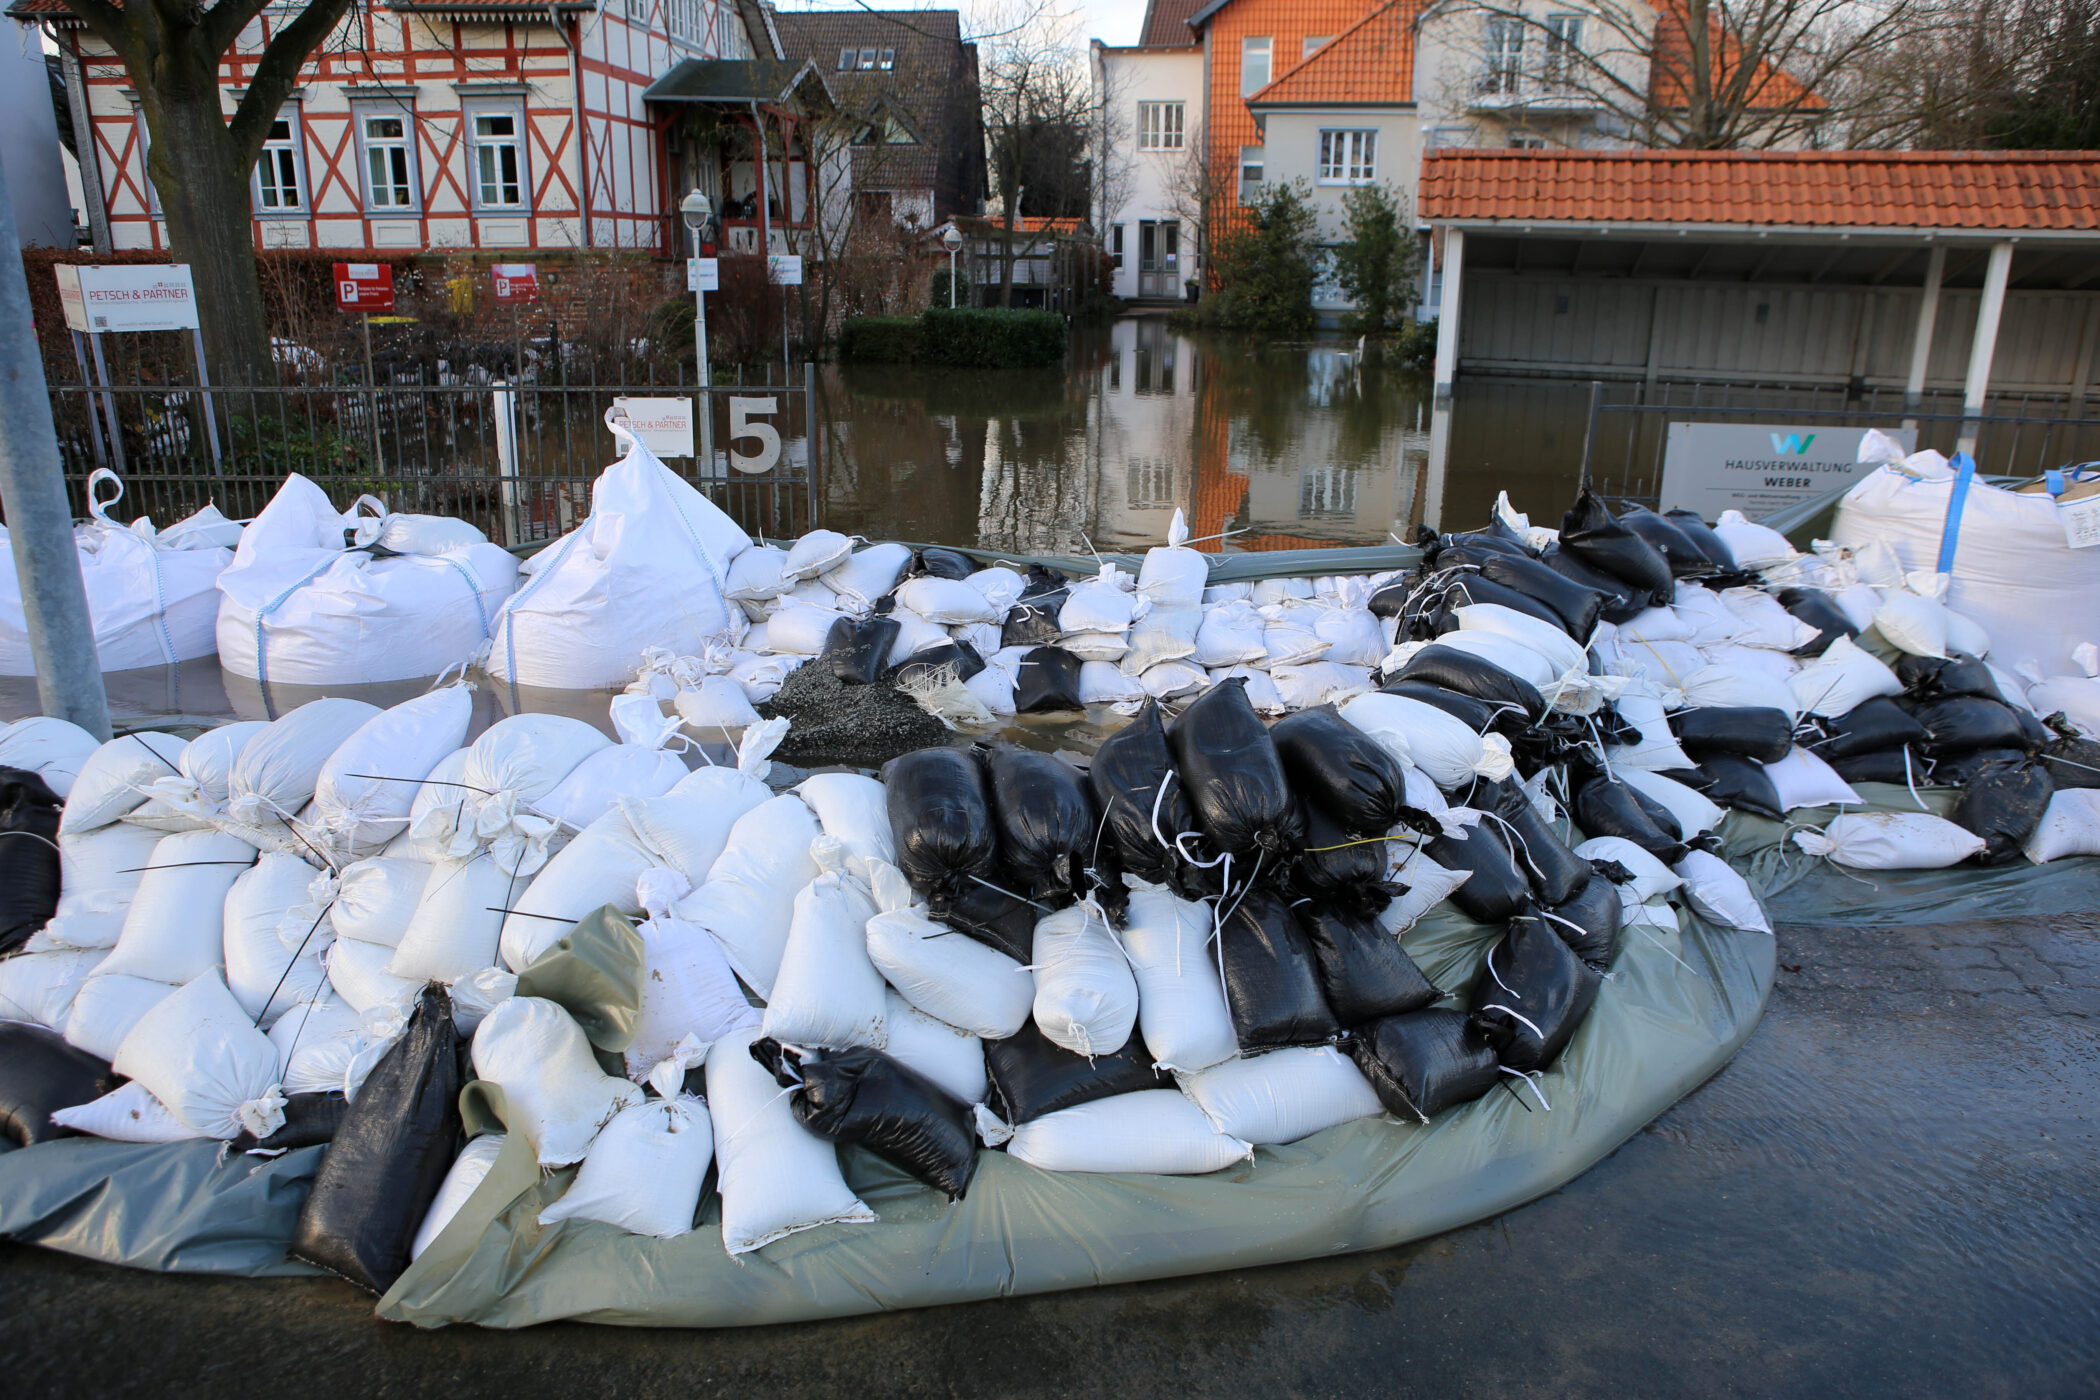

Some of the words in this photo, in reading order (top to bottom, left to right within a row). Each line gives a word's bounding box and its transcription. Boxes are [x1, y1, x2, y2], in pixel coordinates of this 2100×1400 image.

[343, 283, 354, 300] P
[499, 280, 507, 294] P
[89, 291, 130, 301] PETSCH
[132, 290, 141, 300] &
[143, 289, 188, 299] PARTNER
[648, 420, 654, 429] &
[656, 420, 687, 429] PARTNER
[729, 396, 782, 474] 5
[1725, 459, 1853, 473] HAUSVERWALTUNG
[1764, 477, 1811, 487] WEBER
